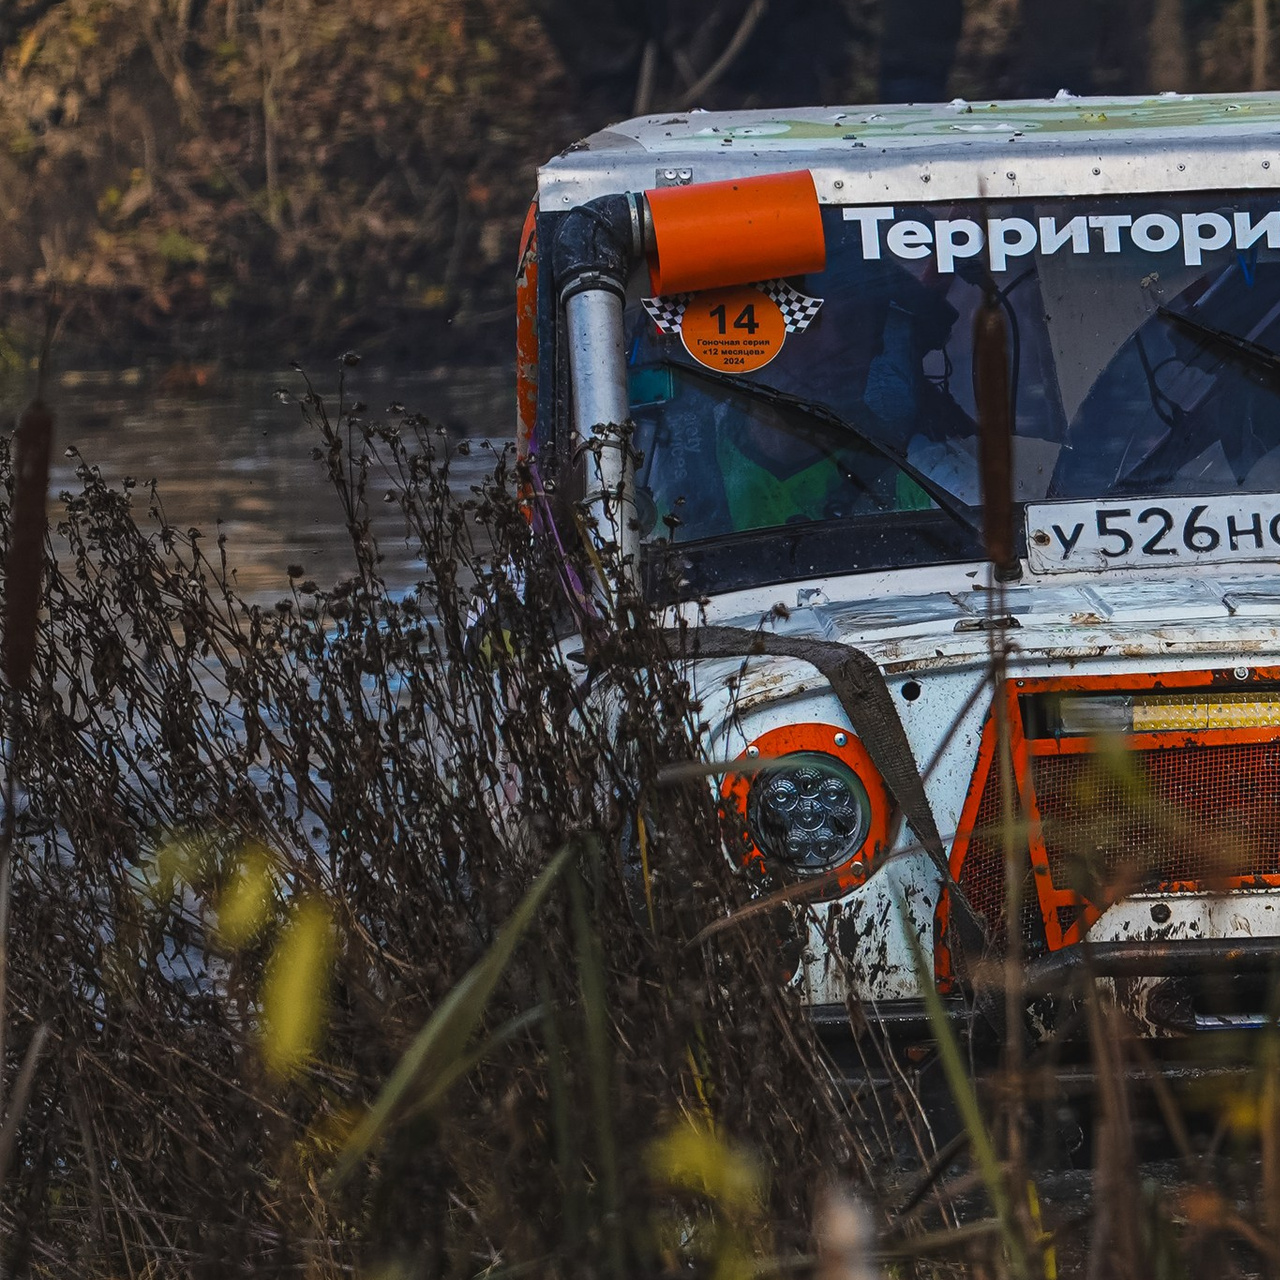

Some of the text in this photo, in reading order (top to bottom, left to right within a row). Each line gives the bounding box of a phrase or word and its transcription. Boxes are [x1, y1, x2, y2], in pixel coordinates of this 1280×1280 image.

[709, 303, 760, 335] 14
[743, 339, 770, 347] серия
[723, 357, 745, 365] 2024
